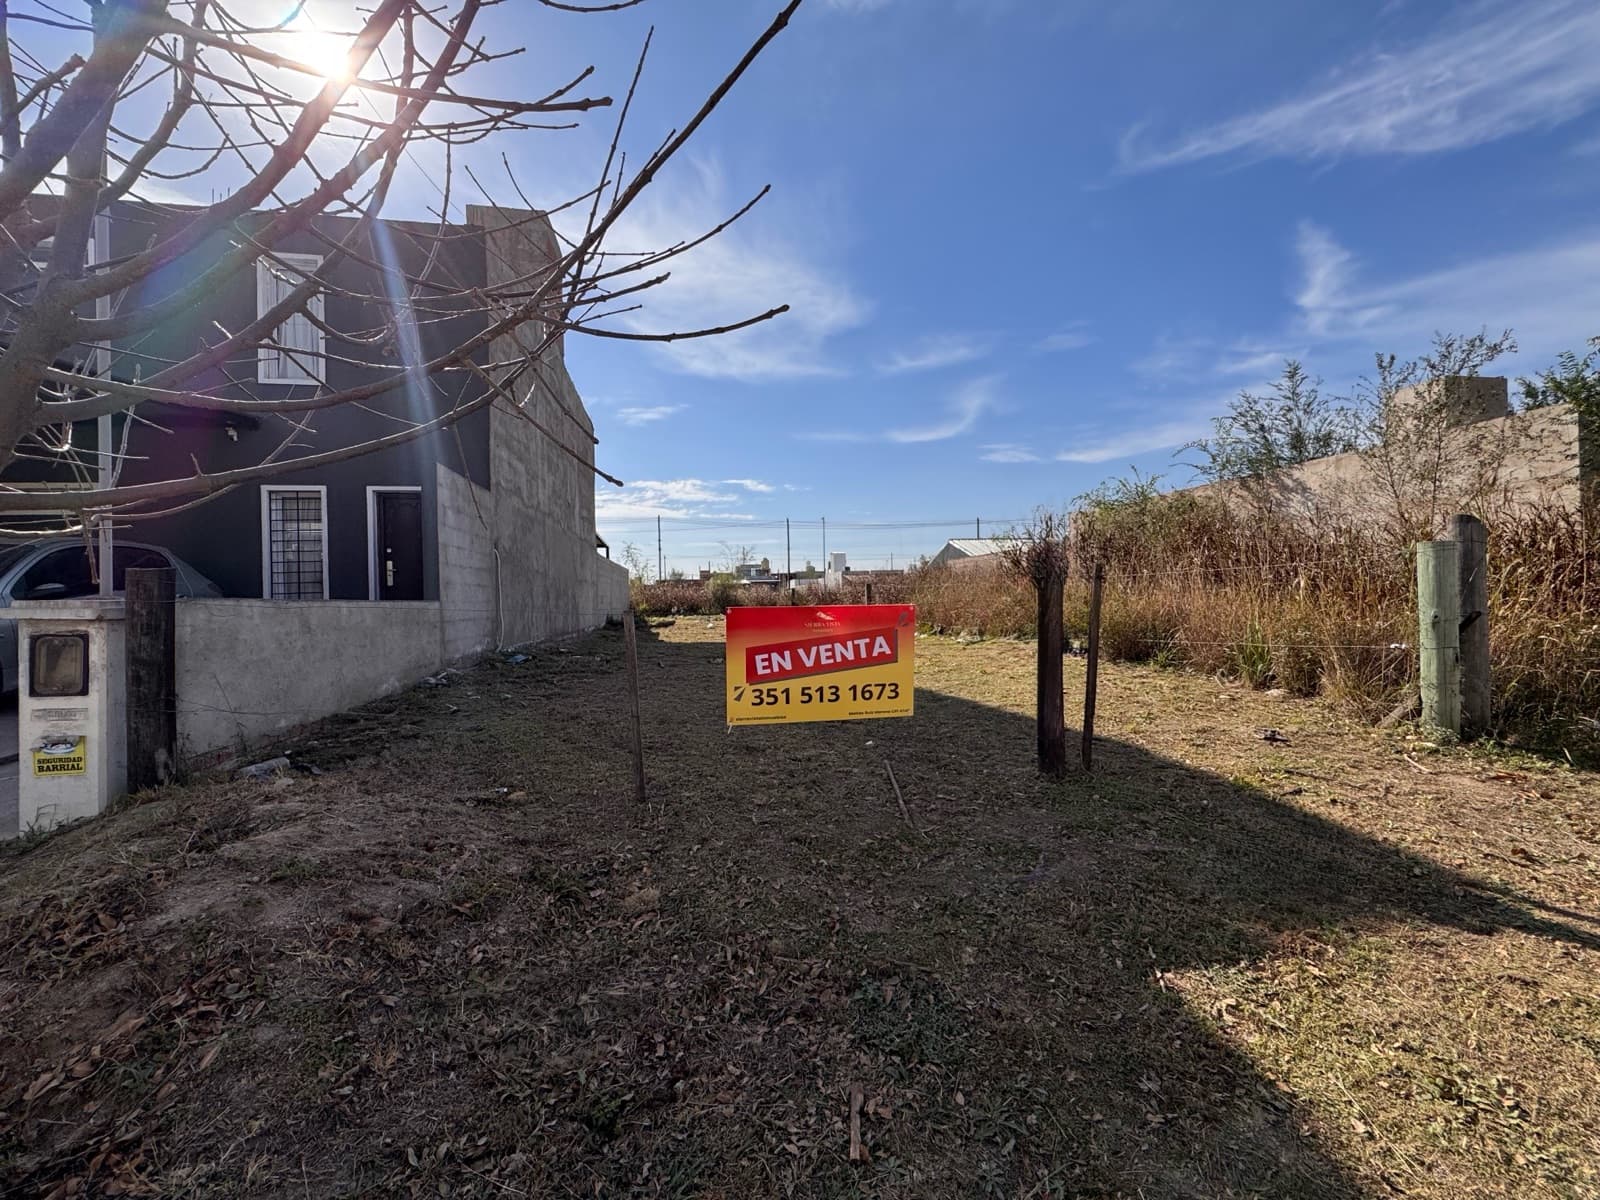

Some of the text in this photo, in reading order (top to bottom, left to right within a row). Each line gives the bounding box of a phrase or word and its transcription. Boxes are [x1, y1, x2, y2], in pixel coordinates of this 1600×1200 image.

[754, 635, 892, 676] EN VENTA
[751, 682, 900, 706] 351 513 1673
[36, 756, 83, 764] SEGURIDAD
[37, 763, 83, 773] BARRIAL
